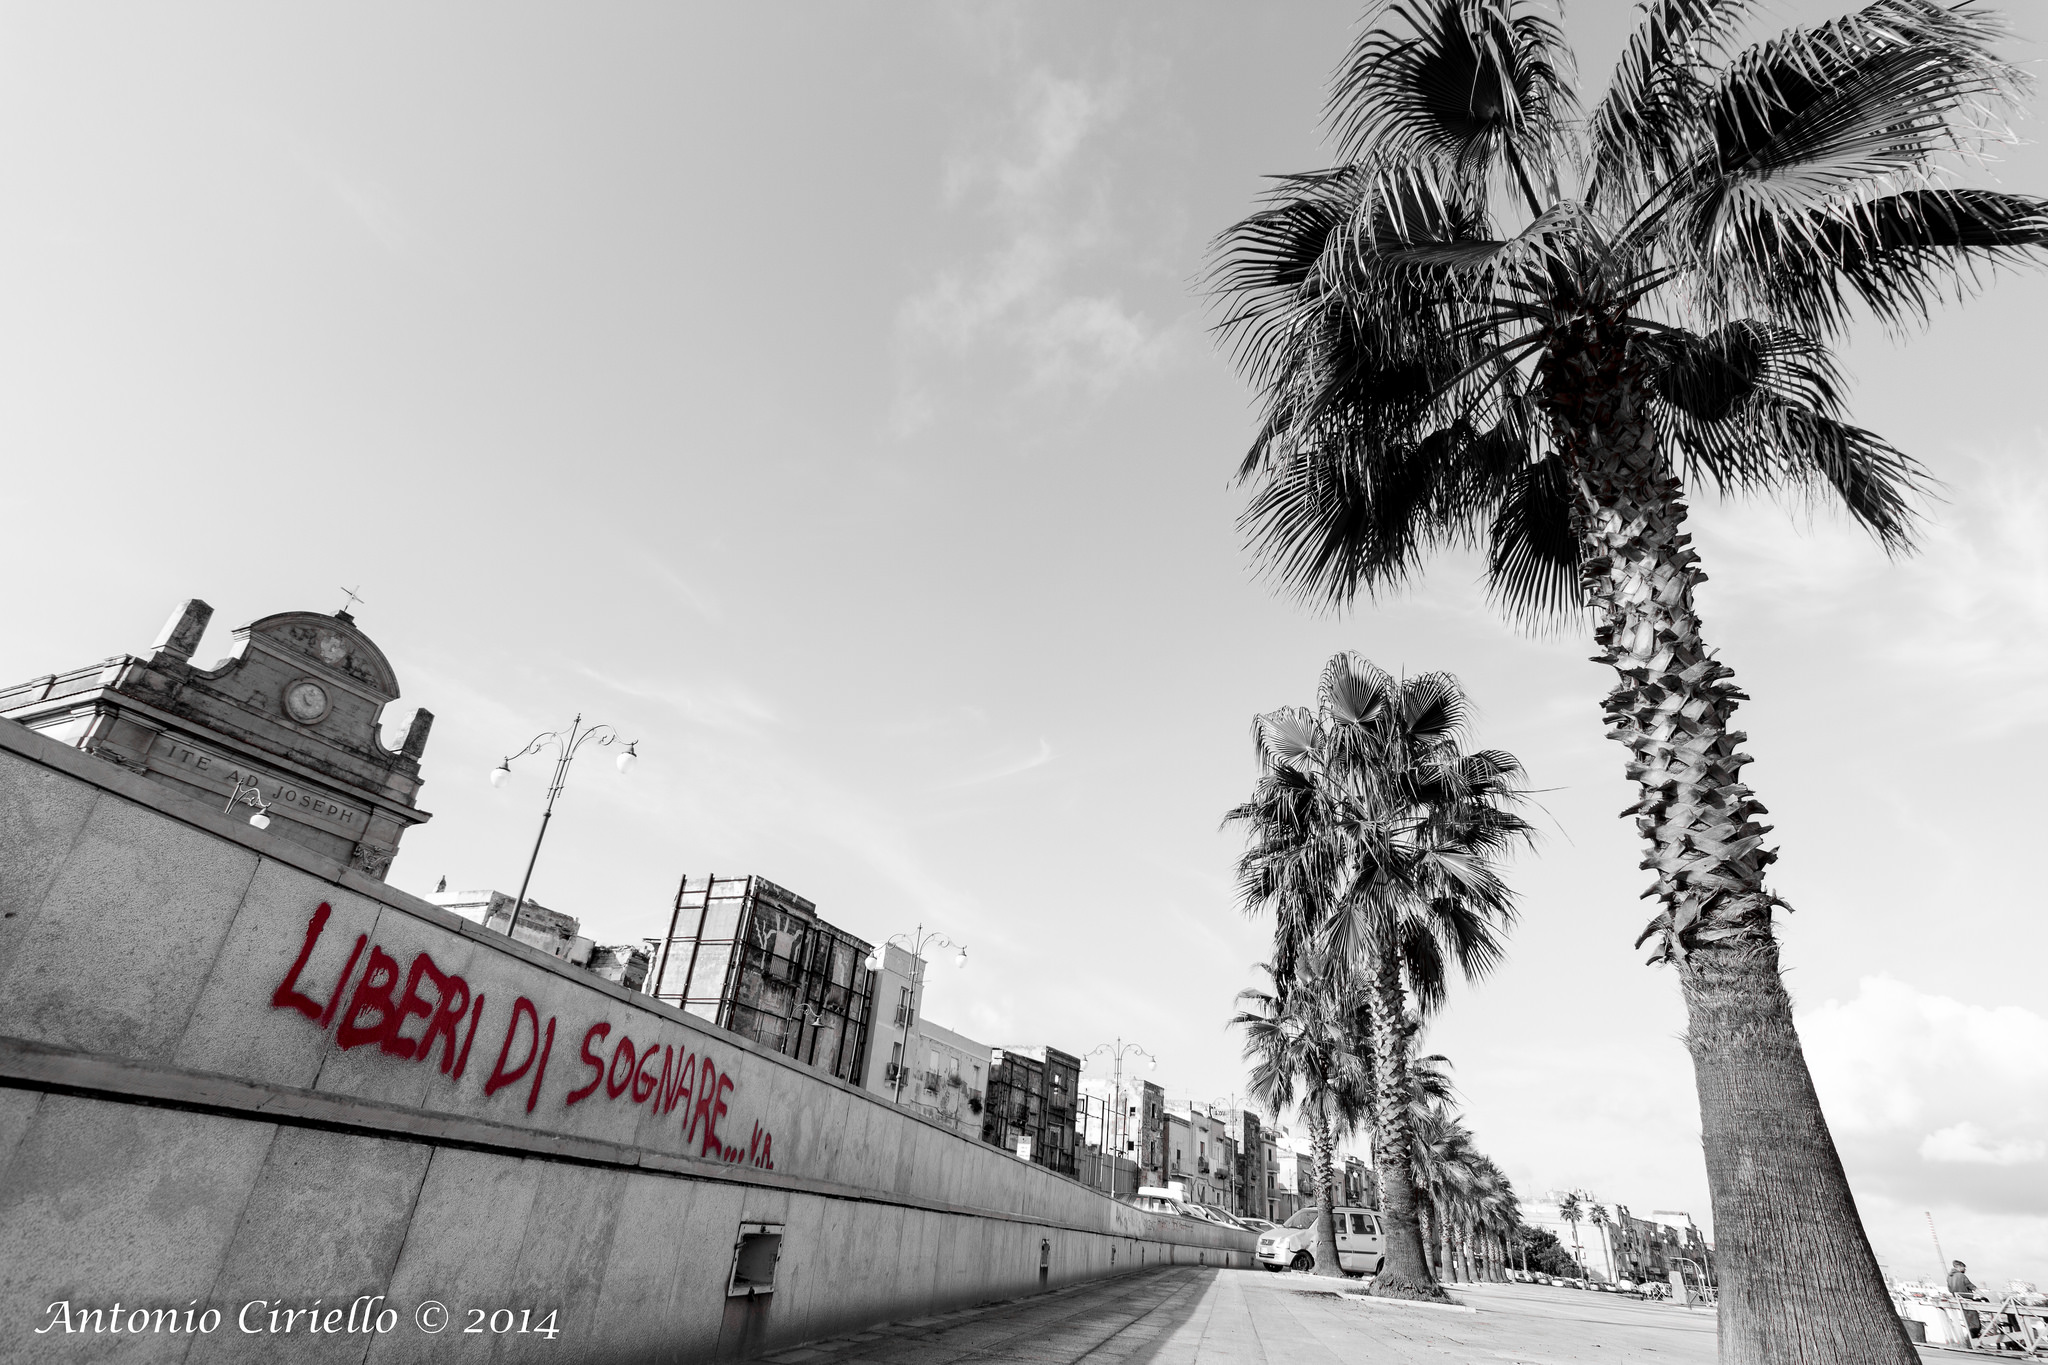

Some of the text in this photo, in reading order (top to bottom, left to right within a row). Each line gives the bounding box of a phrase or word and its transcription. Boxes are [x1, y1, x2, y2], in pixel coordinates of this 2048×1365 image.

[168, 746, 354, 823] ITE AD JOSEPH
[273, 902, 484, 1081] LIBERI
[485, 997, 557, 1113] DI
